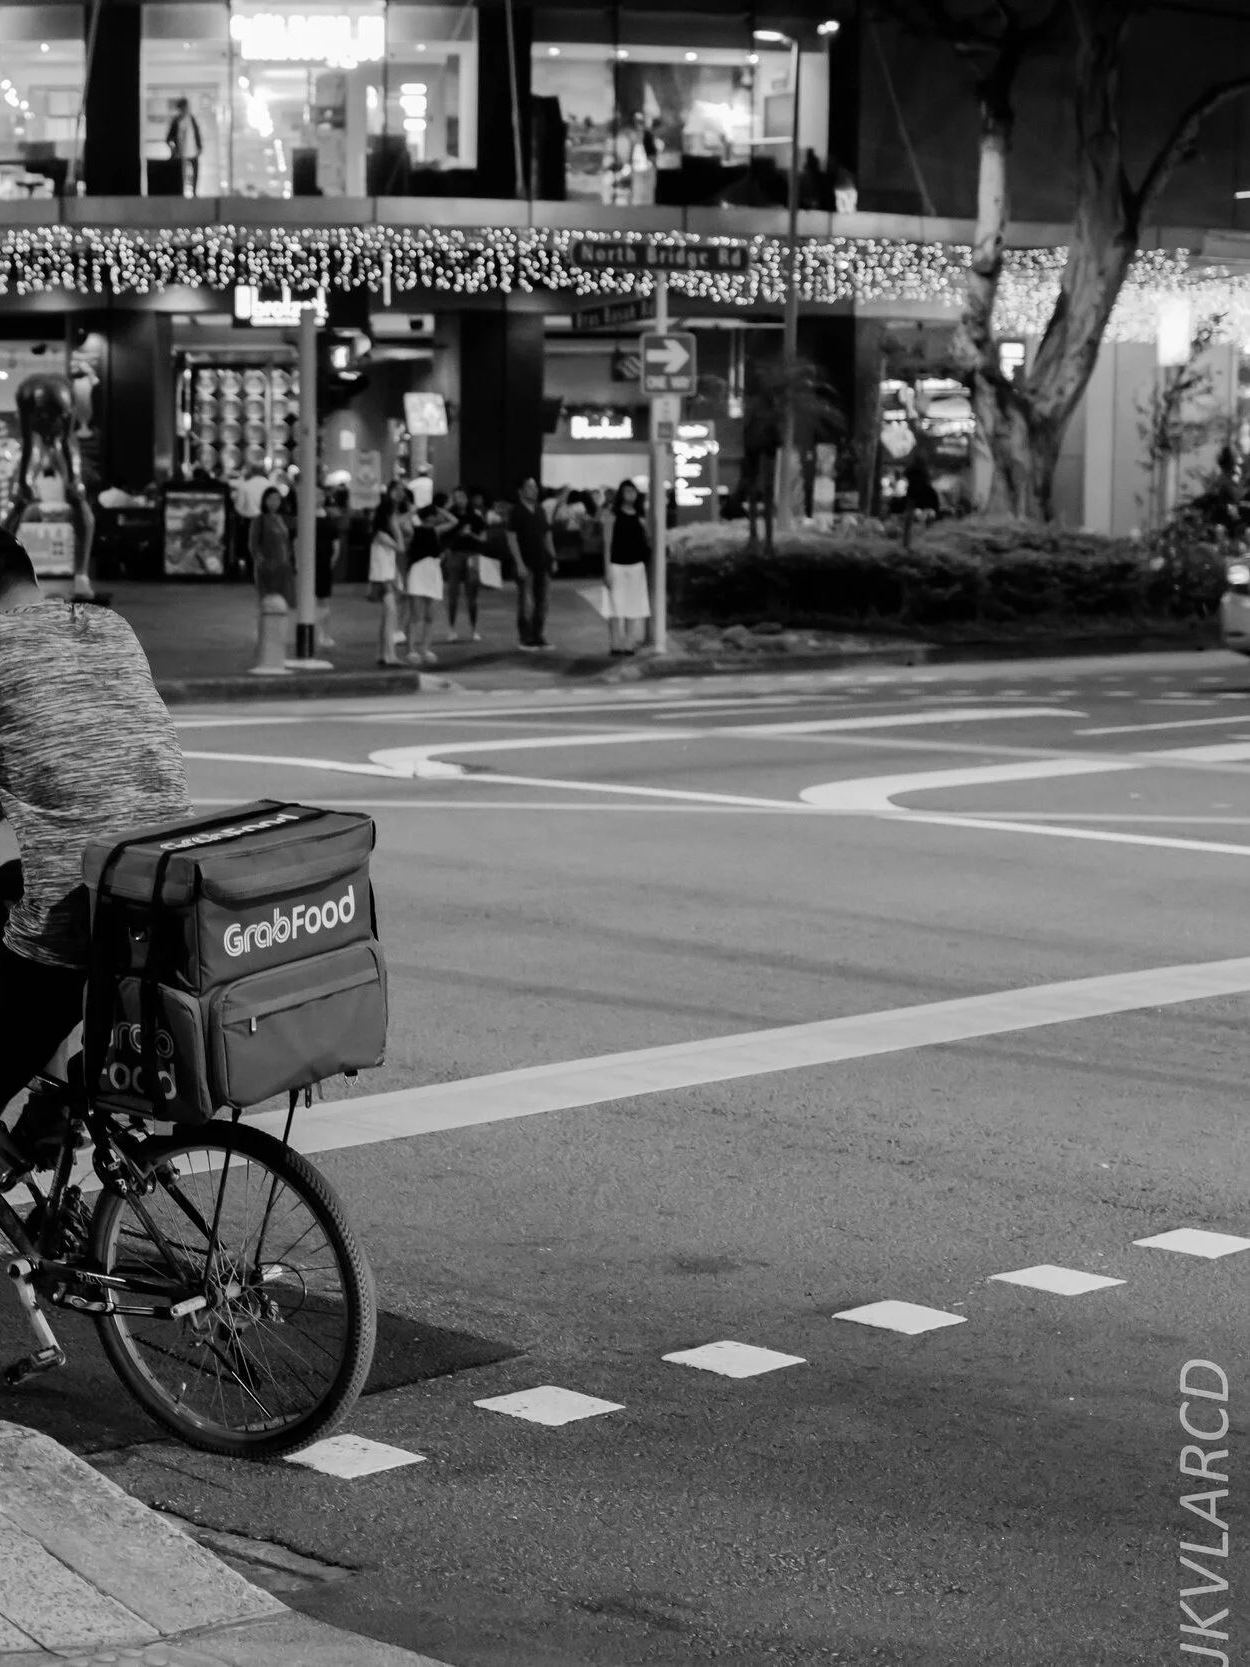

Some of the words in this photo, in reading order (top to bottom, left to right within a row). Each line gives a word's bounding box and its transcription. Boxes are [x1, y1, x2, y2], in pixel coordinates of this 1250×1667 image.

[580, 244, 637, 262] North
[646, 246, 708, 269] Bridge
[718, 247, 742, 266] Rd
[223, 885, 356, 957] GrabFood
